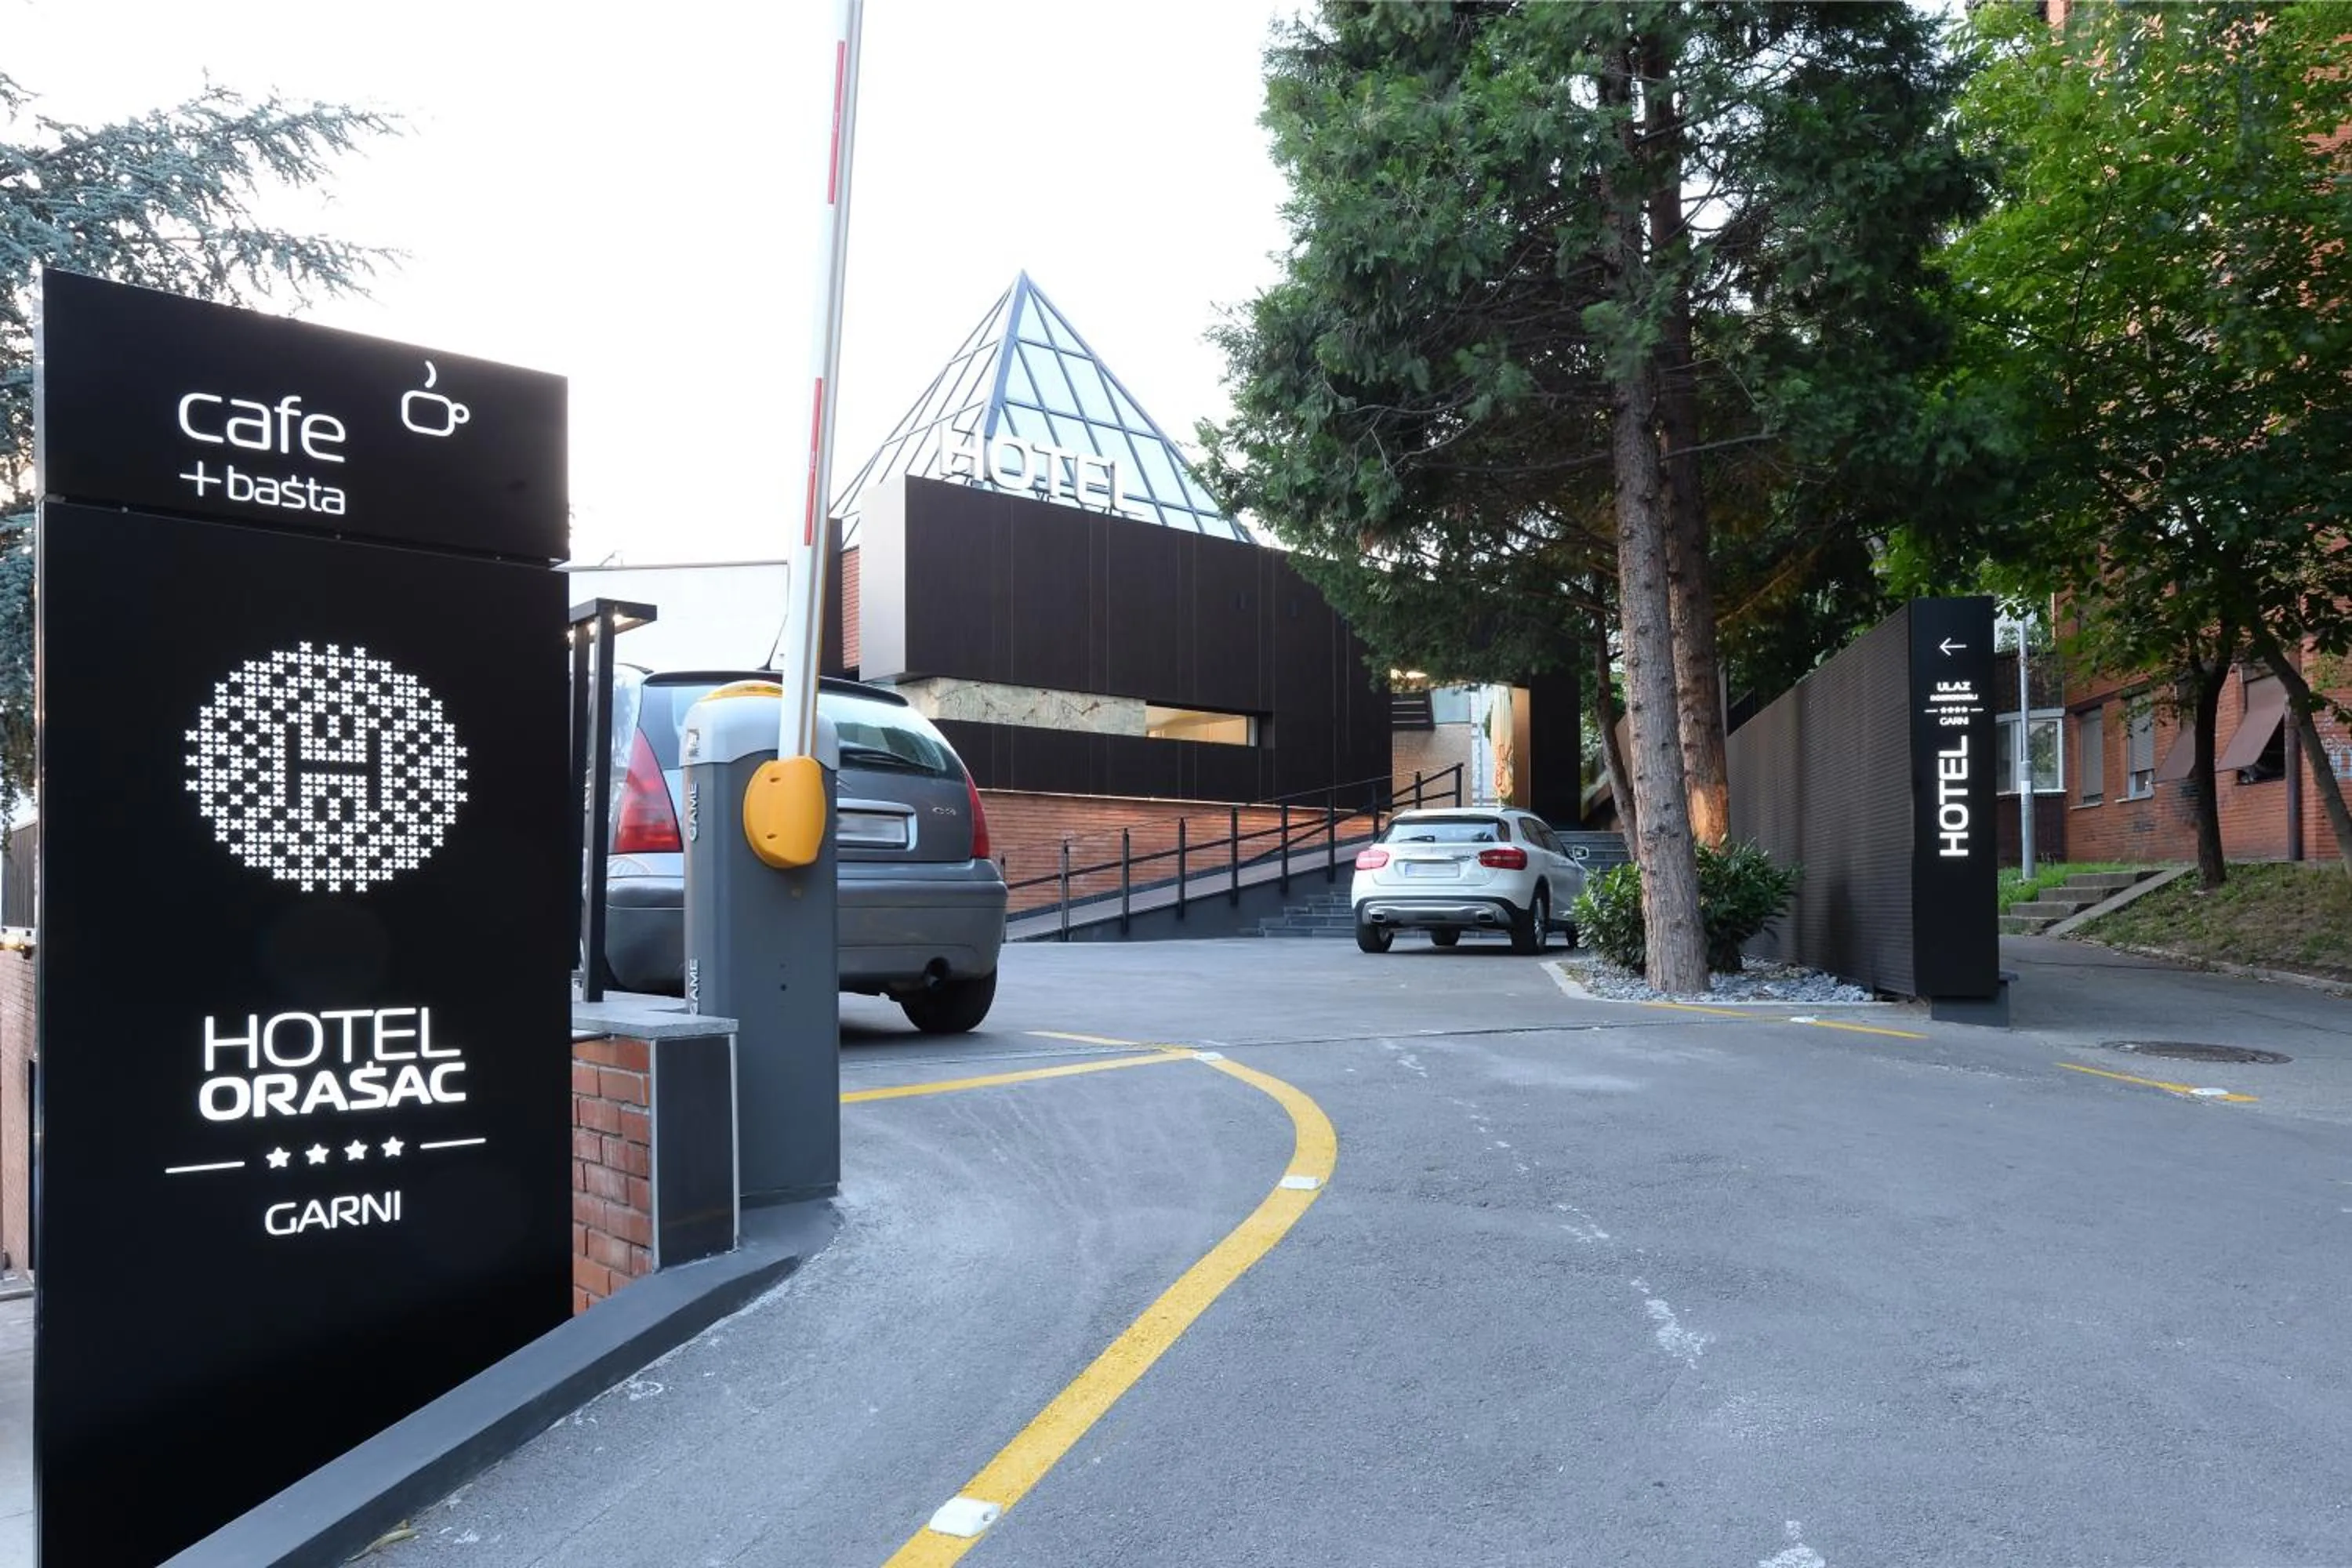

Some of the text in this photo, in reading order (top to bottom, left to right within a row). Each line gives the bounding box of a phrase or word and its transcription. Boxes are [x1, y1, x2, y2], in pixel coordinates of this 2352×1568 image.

[178, 392, 347, 463] cafe
[939, 420, 1144, 516] HOTEL
[1938, 735, 1969, 857] HOTEL
[204, 1007, 463, 1073] HOTEL
[263, 1190, 401, 1236] GARNI
